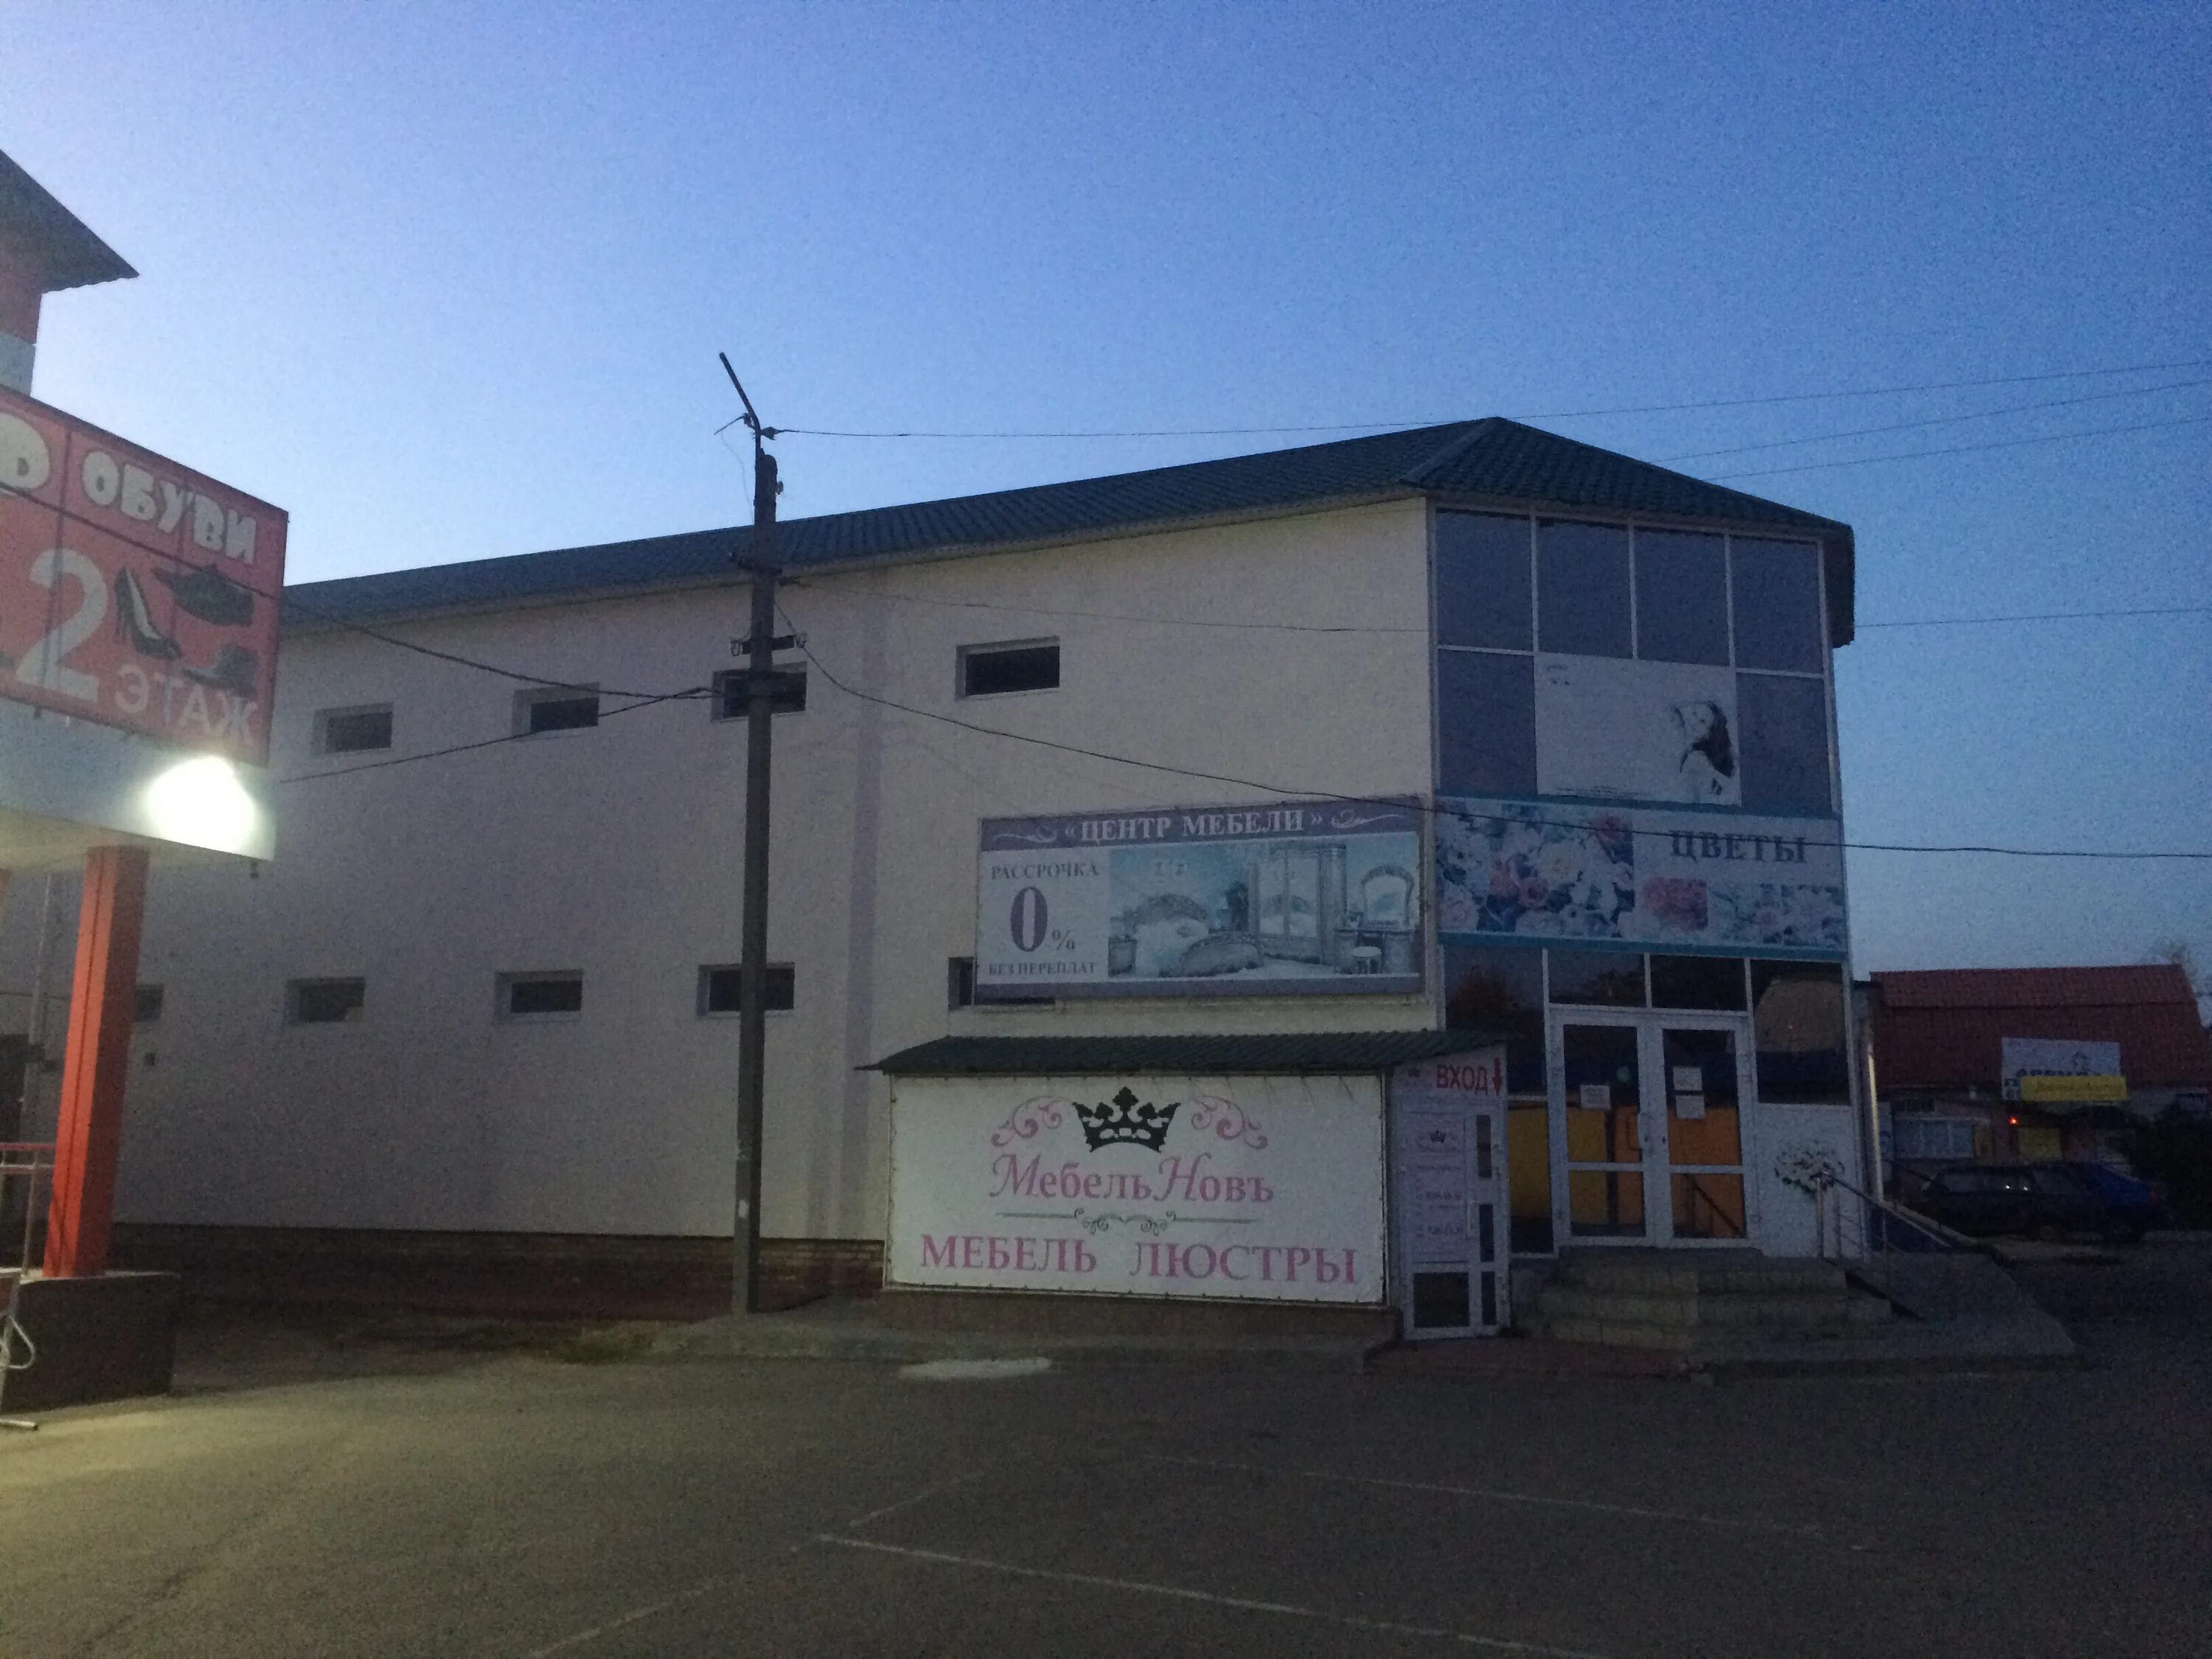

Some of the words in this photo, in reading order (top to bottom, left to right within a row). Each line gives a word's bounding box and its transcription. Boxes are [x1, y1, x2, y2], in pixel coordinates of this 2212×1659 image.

[82, 451, 257, 565] ОБУВИ
[16, 548, 108, 702] 2
[114, 665, 260, 742] ЭТАЖ
[1669, 830, 1807, 863] ЦВЕТЫ
[991, 861, 1099, 880] РАССРОЧКА
[989, 964, 1015, 976] БЕЗ
[1018, 961, 1097, 975] ПЕРЕПЛАТ
[1436, 1064, 1488, 1095] ВХОД
[920, 1234, 1097, 1274] МЕБЕЛЬ
[1129, 1242, 1357, 1284] ЛЮСТРЫ
